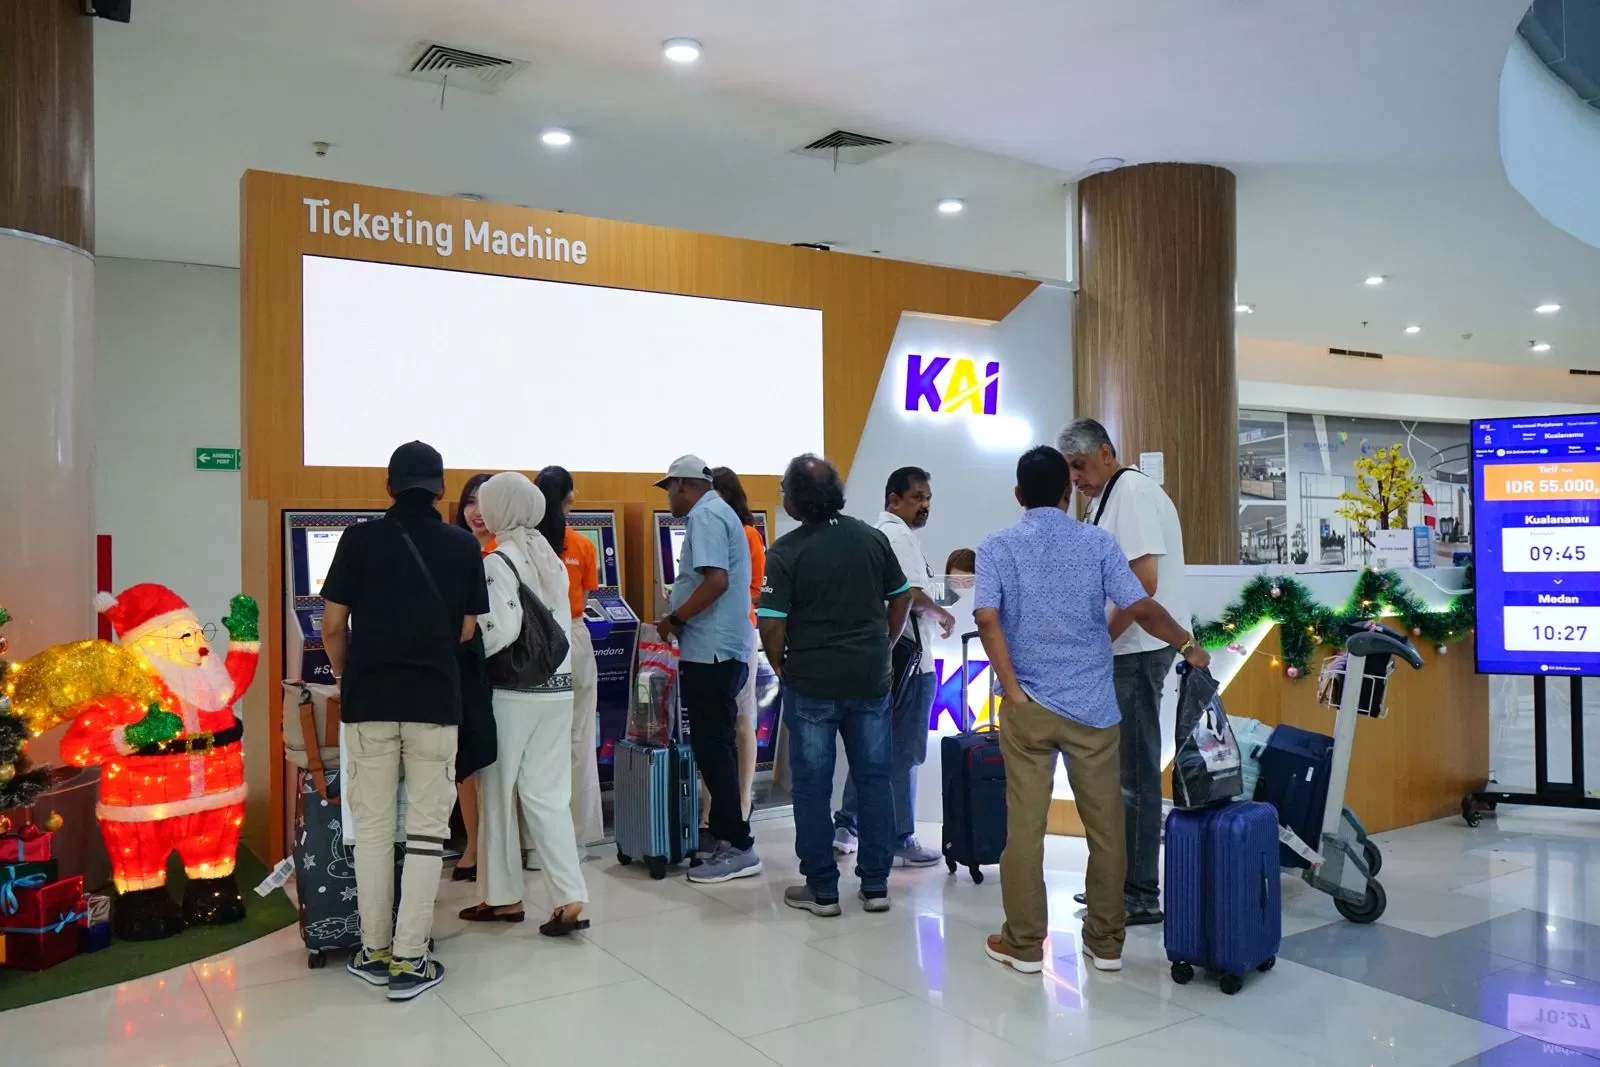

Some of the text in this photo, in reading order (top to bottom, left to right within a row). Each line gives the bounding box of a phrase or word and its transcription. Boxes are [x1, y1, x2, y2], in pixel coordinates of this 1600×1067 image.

[303, 198, 588, 265] Ticketing Machine
[905, 354, 999, 415] KAI
[1505, 480, 1535, 493] IDR
[1525, 515, 1590, 524] Kualanamu
[1530, 546, 1586, 561] 09:45
[1538, 594, 1580, 604] Medan
[1533, 625, 1587, 641] 10:27
[592, 647, 625, 657] andara
